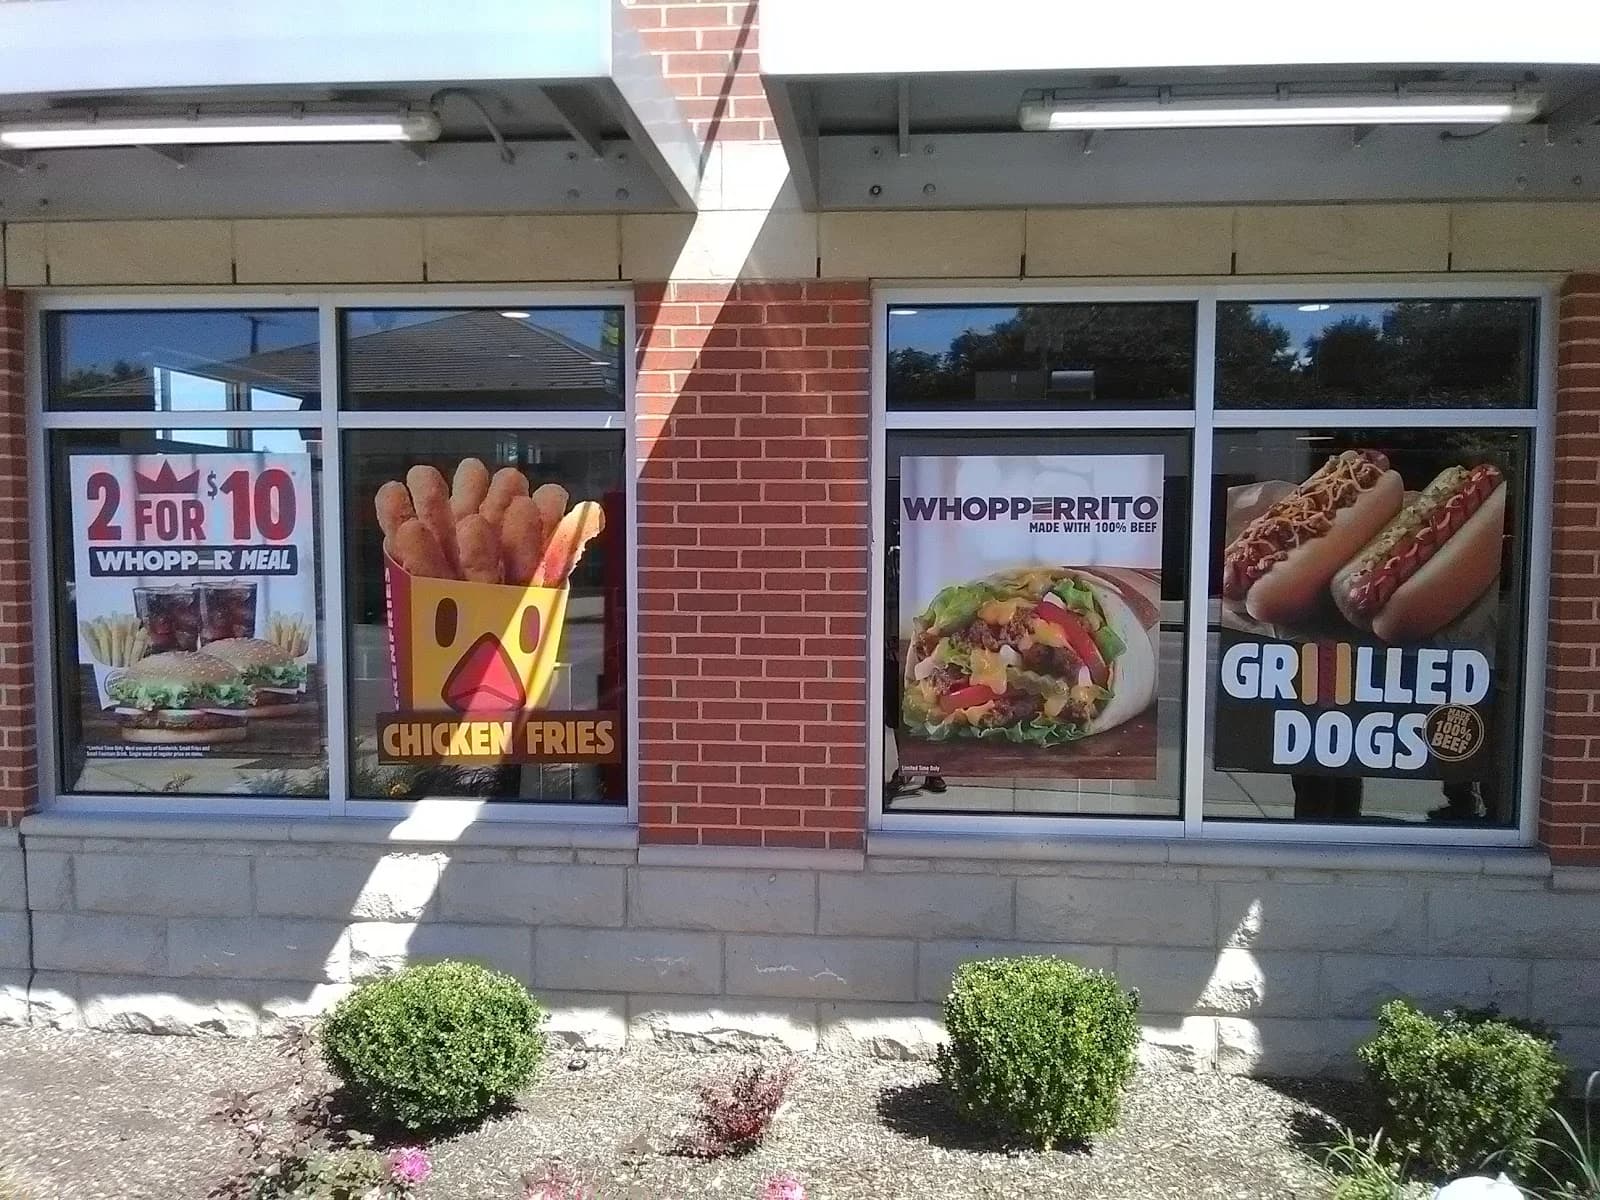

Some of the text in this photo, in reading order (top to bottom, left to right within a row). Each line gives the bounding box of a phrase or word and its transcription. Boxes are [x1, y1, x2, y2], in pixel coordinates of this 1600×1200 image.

[87, 472, 122, 541] 2
[135, 499, 206, 541] FOR
[902, 496, 1159, 521] WHOPPERRITO
[1029, 521, 1158, 533] MADE WITH 100% BEEF
[239, 549, 292, 571] MEAL
[382, 720, 615, 757] CHICKEN FRIES
[1272, 709, 1429, 770] DOGS
[1435, 720, 1472, 742] 100%
[1431, 732, 1469, 754] BEEF
